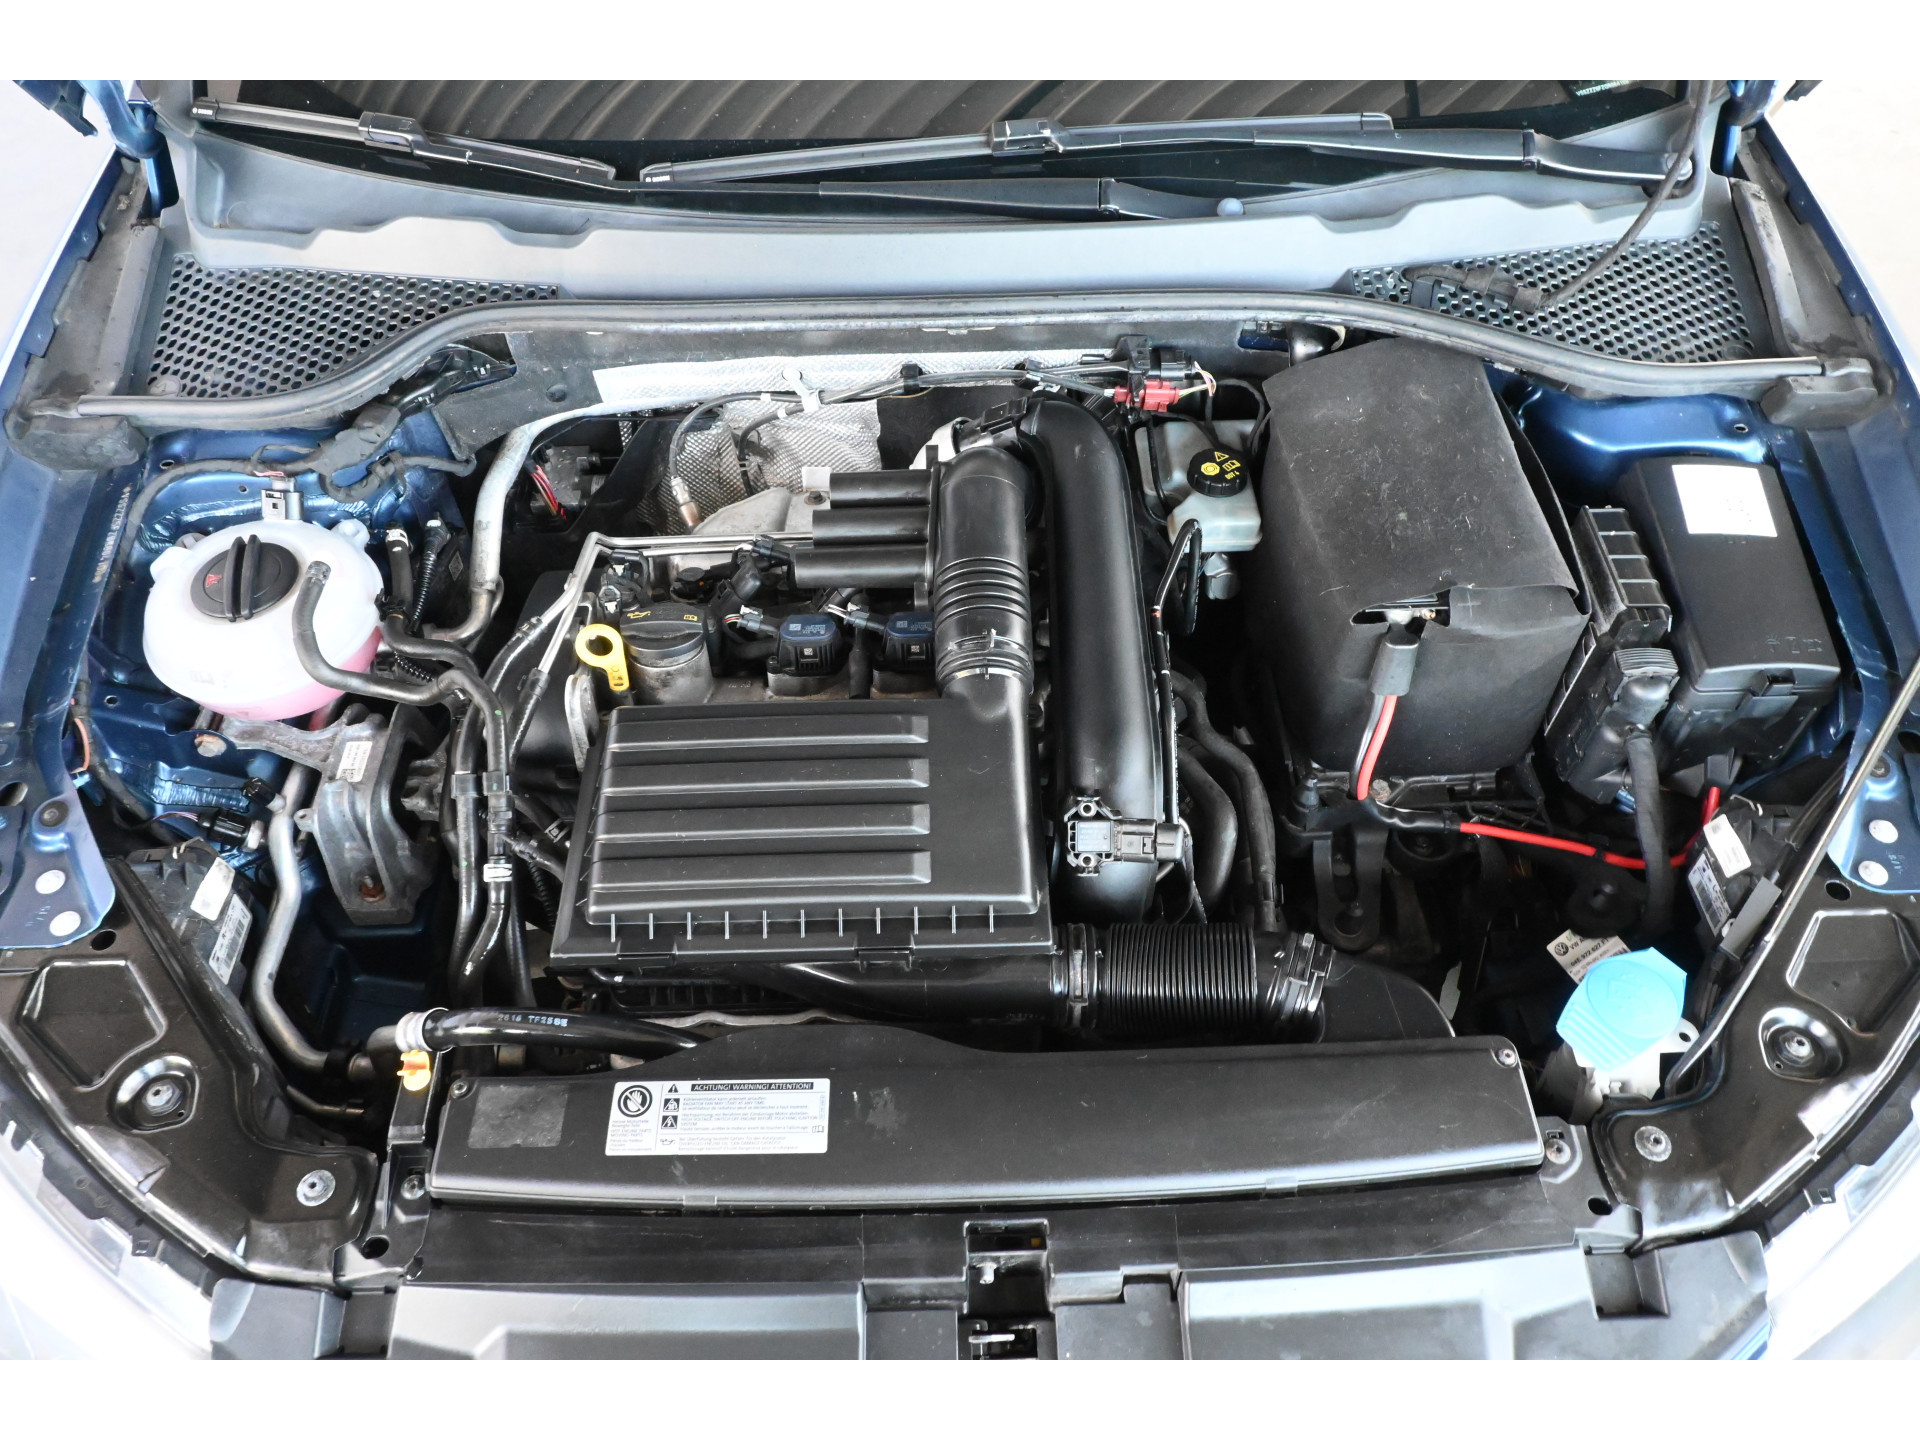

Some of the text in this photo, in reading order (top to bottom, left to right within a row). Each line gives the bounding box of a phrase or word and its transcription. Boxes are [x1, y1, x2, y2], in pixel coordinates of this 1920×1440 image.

[694, 1082, 812, 1092] ACHTUNG! WARNING! ATTENTION!
